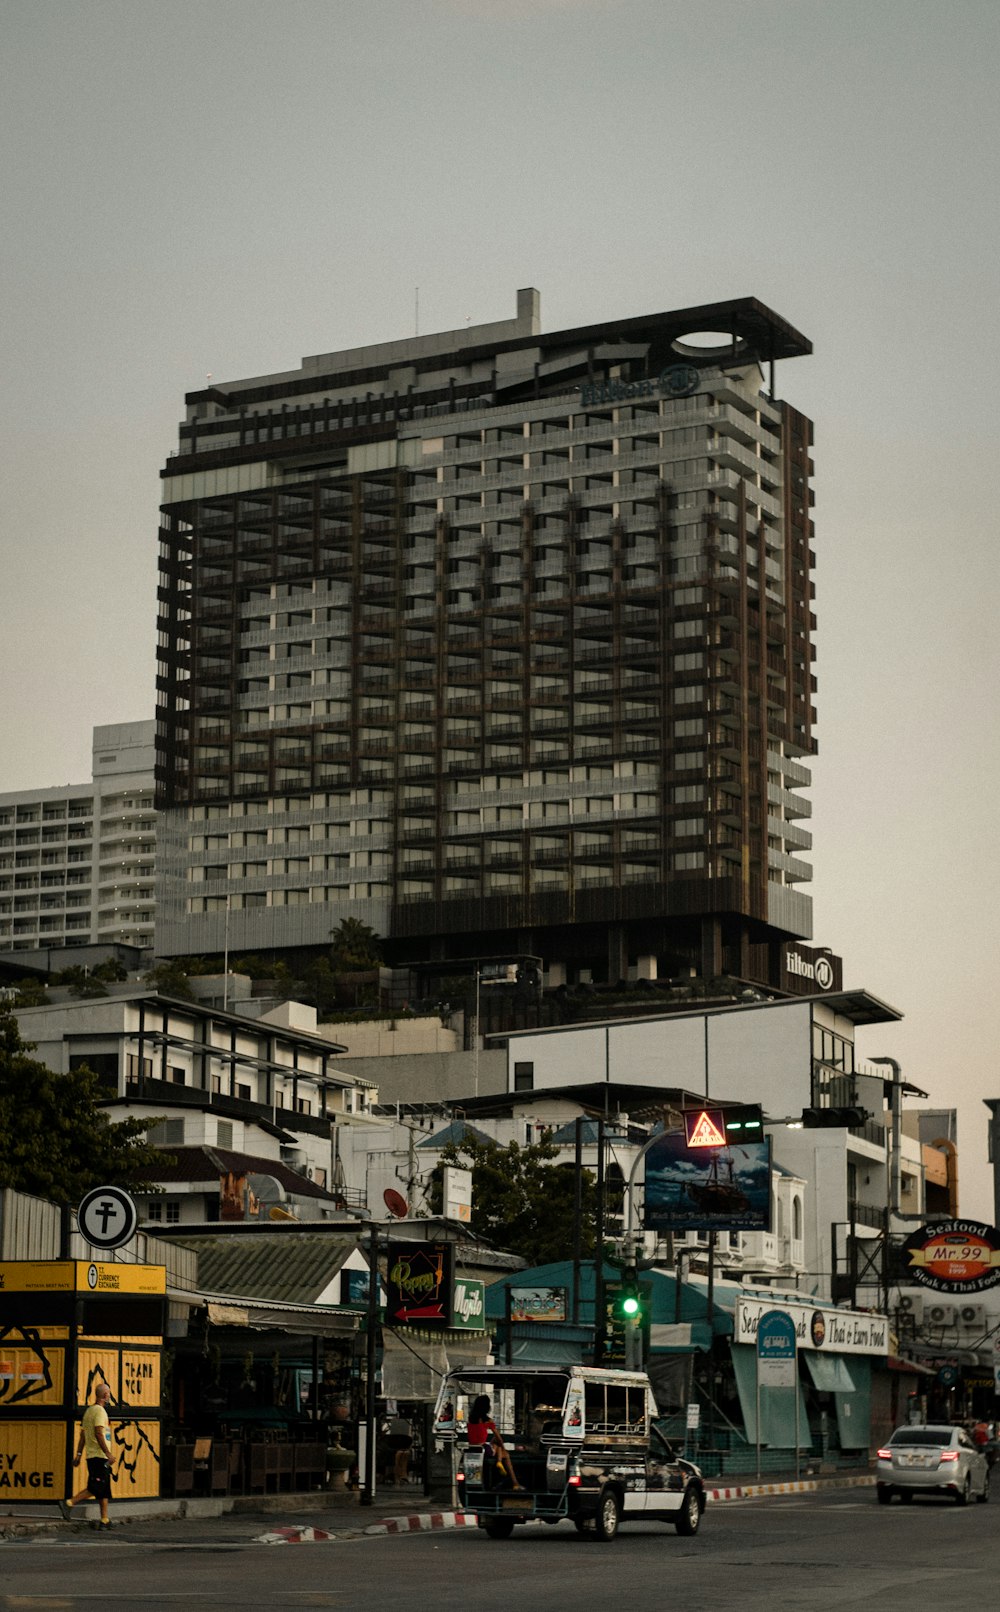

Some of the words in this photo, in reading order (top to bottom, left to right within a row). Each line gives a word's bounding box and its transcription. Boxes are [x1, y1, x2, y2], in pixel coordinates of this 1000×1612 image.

[926, 1220, 988, 1238] Seafood
[933, 1247, 982, 1260] Mr.99
[98, 1274, 120, 1282] CURRENCY
[98, 1281, 120, 1289] EXCHANGE
[913, 1268, 939, 1289] Steak
[952, 1282, 976, 1291] Thai
[978, 1269, 1000, 1288] Food
[514, 1296, 561, 1310] NICK'S
[742, 1306, 763, 1335] Seaf
[829, 1318, 845, 1344] Thai
[853, 1322, 868, 1346] Euro
[870, 1323, 885, 1347] Food
[125, 1379, 143, 1395] YOU
[0, 1454, 18, 1470] Y
